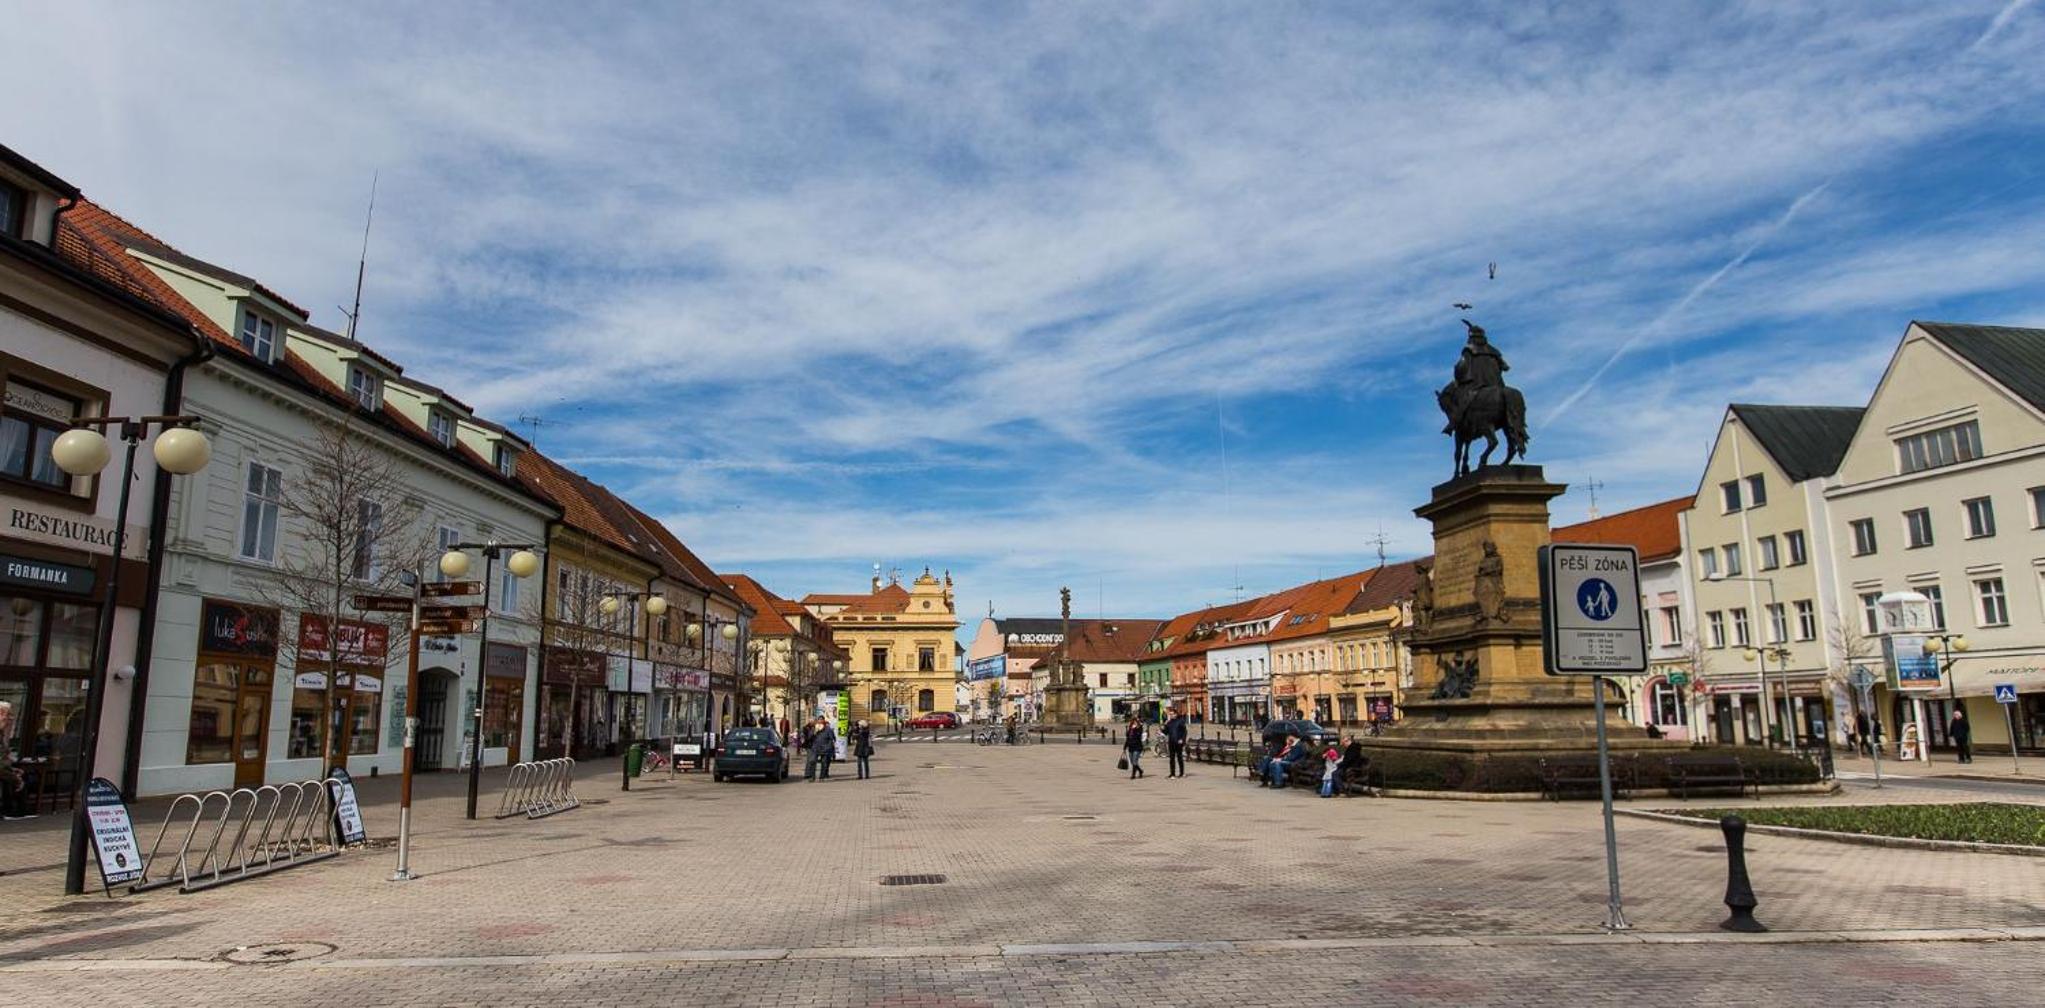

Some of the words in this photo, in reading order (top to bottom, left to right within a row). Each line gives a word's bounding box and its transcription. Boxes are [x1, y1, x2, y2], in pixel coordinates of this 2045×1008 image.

[10, 508, 129, 549] RESTAURACE
[7, 562, 68, 584] FORMANKA
[1560, 555, 1588, 571] PĚŠÍ
[1594, 556, 1628, 571] ZÓNA
